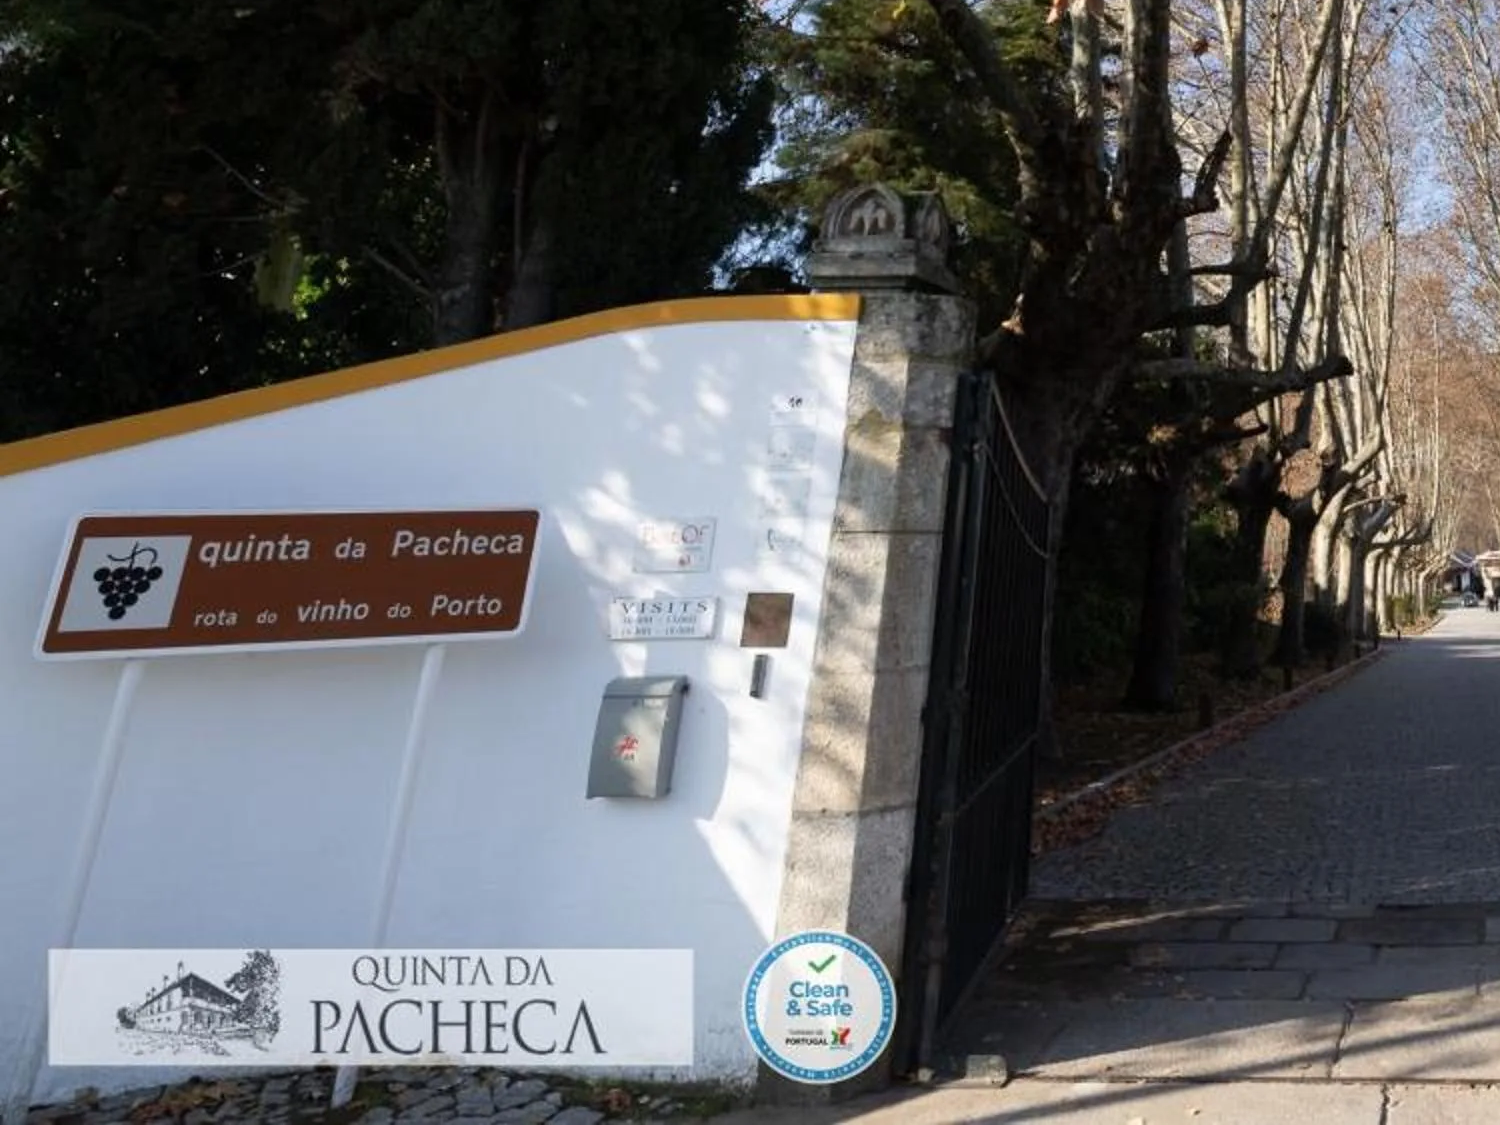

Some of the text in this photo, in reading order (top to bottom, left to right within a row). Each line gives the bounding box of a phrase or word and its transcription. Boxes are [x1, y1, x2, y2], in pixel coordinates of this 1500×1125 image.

[199, 530, 523, 567] quinta da Pacheca
[193, 594, 502, 627] rota do vinho do Porto
[622, 600, 709, 614] VISITS
